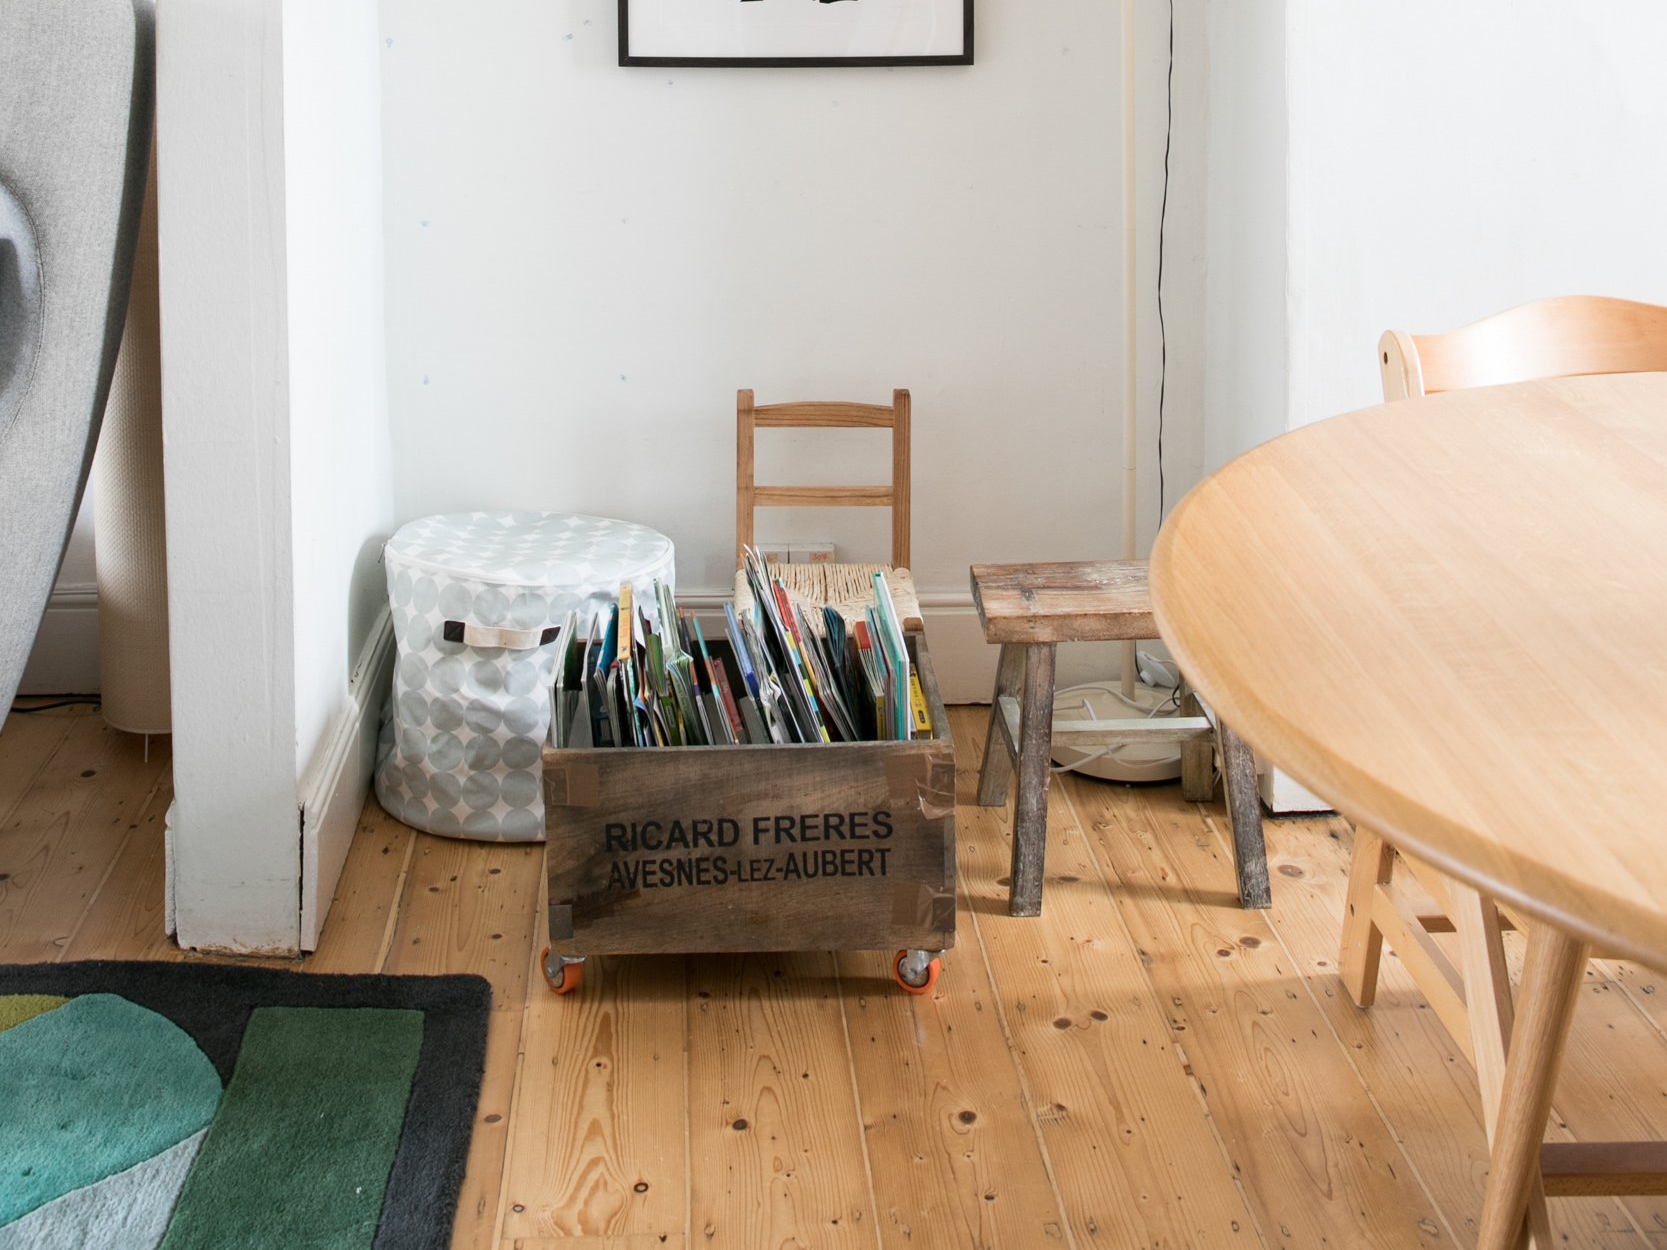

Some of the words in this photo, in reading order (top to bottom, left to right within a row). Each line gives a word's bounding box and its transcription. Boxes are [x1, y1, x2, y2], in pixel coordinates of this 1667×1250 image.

[605, 817, 740, 851] RICARD
[752, 810, 893, 845] FRERES
[606, 848, 892, 890] AVESNES-LEZ-AUBERT
